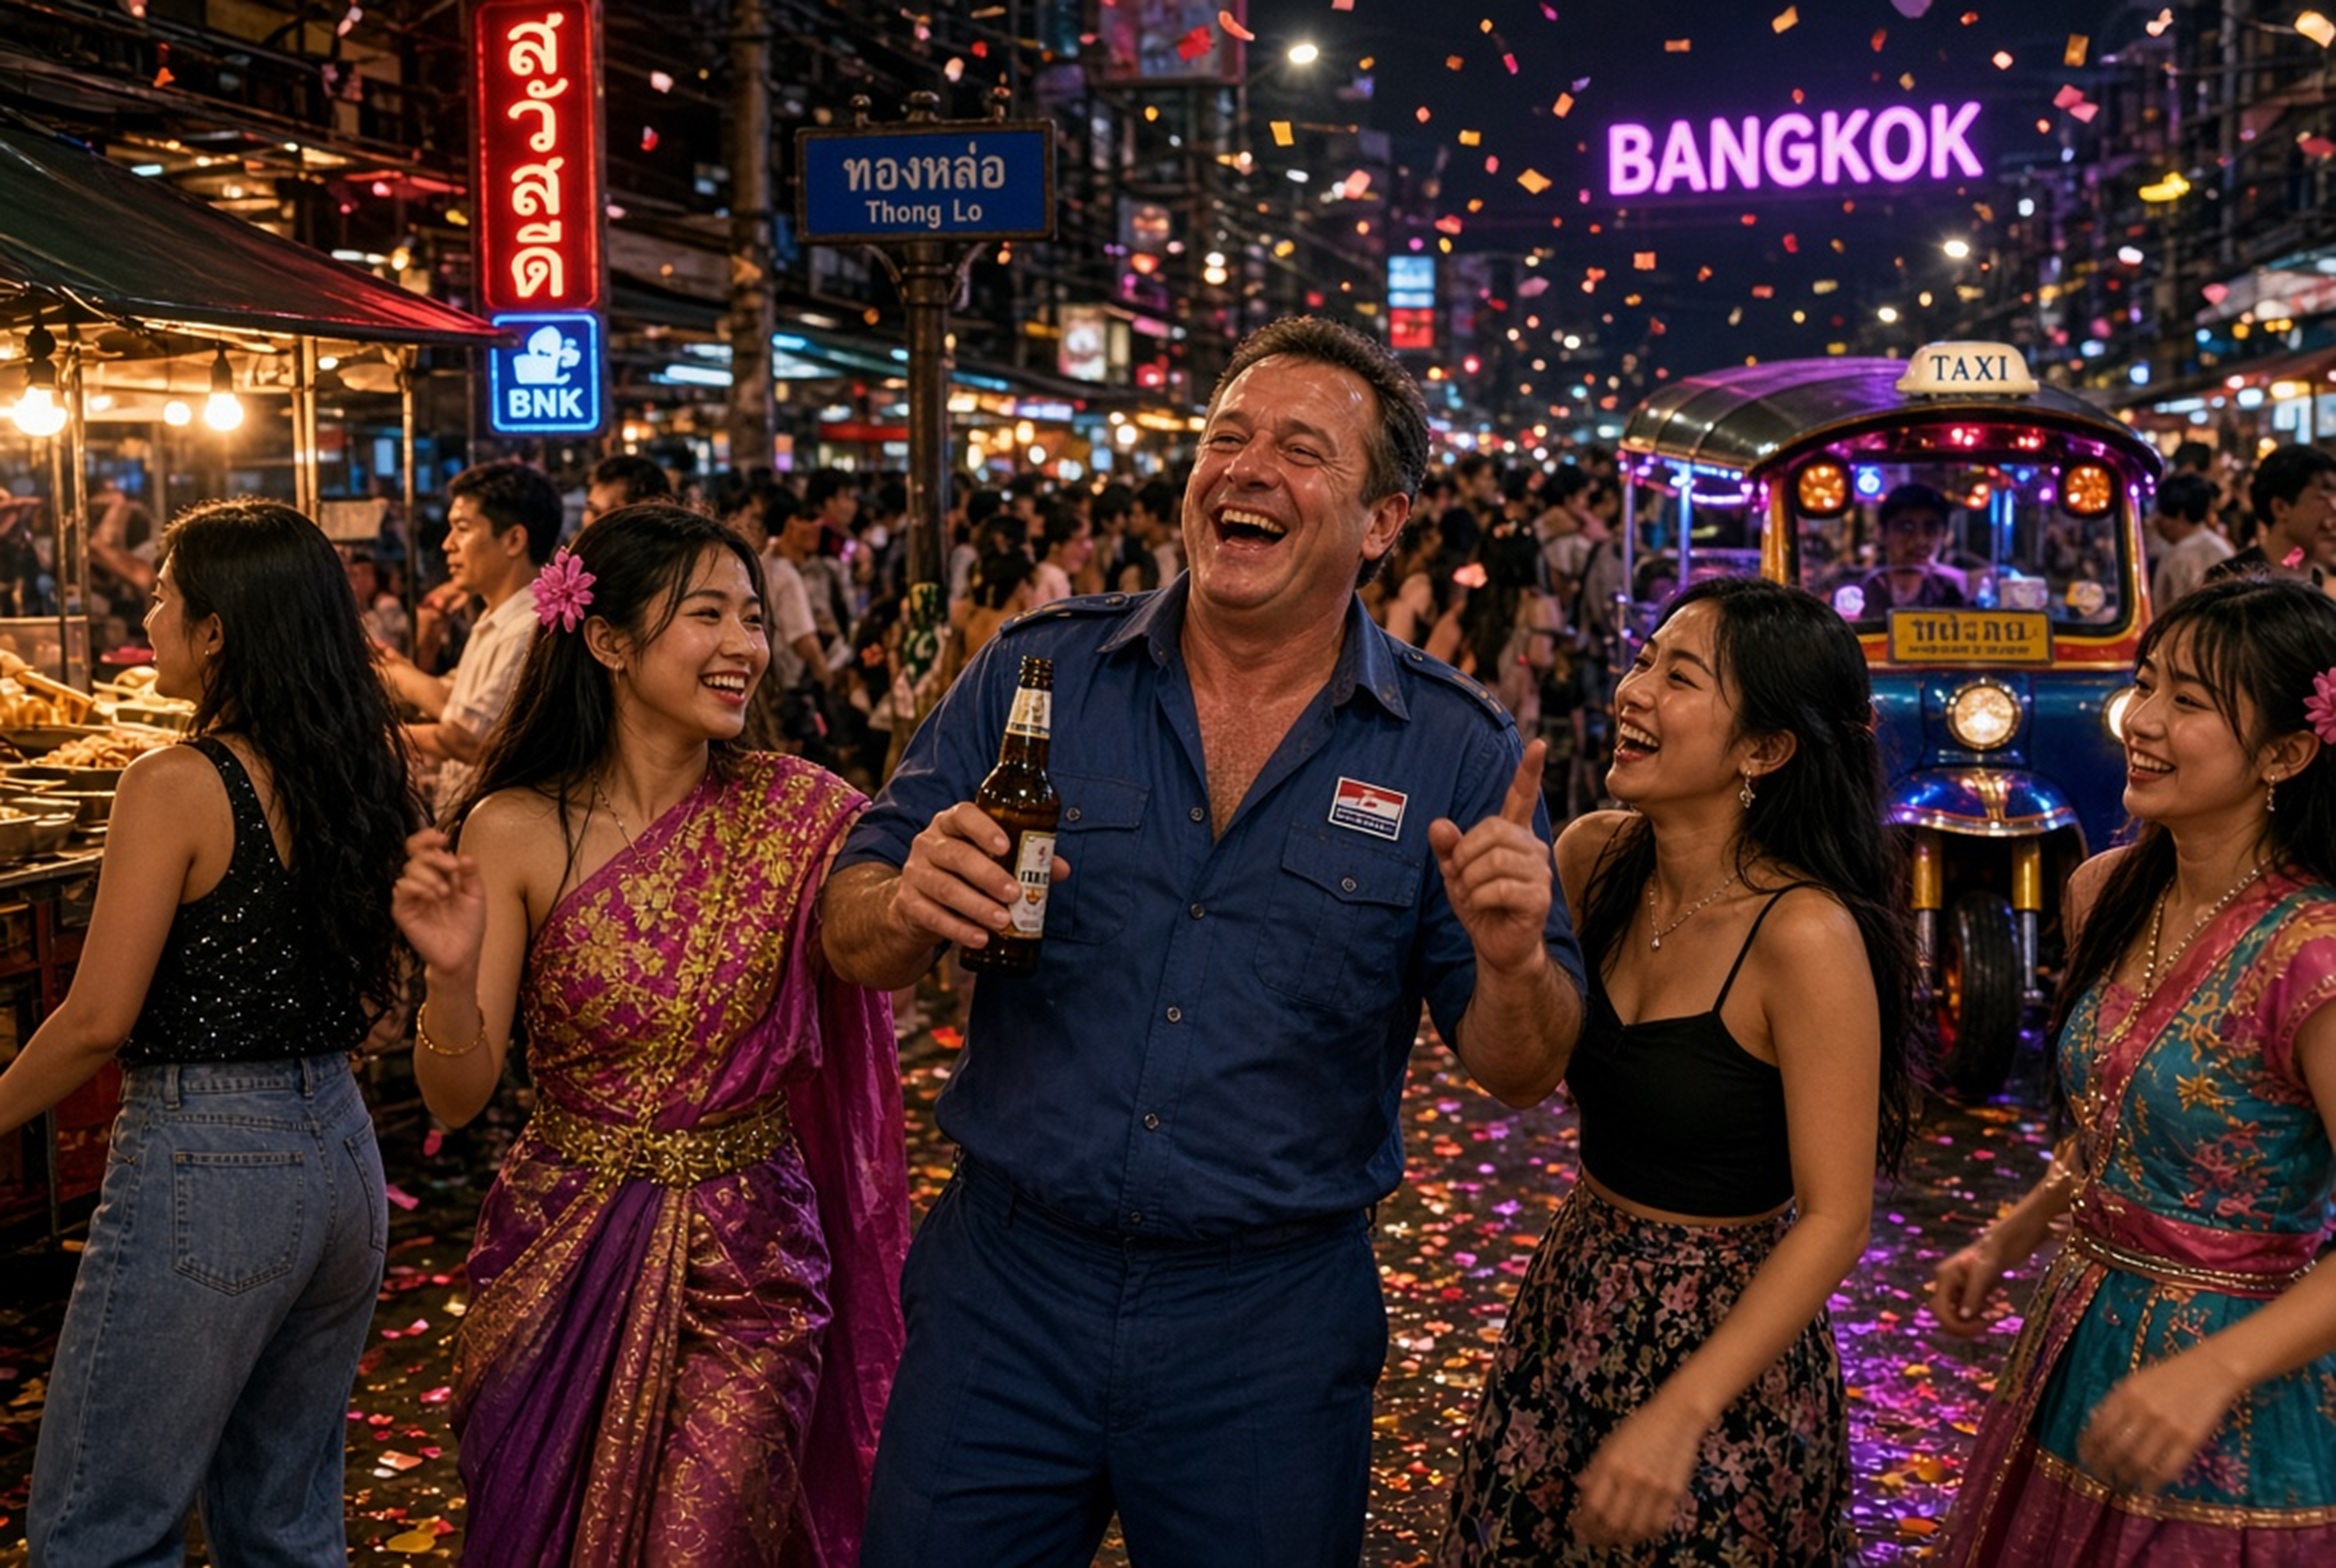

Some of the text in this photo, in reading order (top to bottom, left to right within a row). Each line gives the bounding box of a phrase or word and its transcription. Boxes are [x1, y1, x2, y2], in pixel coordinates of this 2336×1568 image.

[508, 12, 568, 298] สวัสดี
[843, 141, 1005, 191] ทองหล่อ
[1608, 101, 1984, 195] BANGKOK
[865, 198, 982, 229] Thong Lo
[1929, 355, 2007, 381] TAXI
[508, 387, 584, 419] BNK
